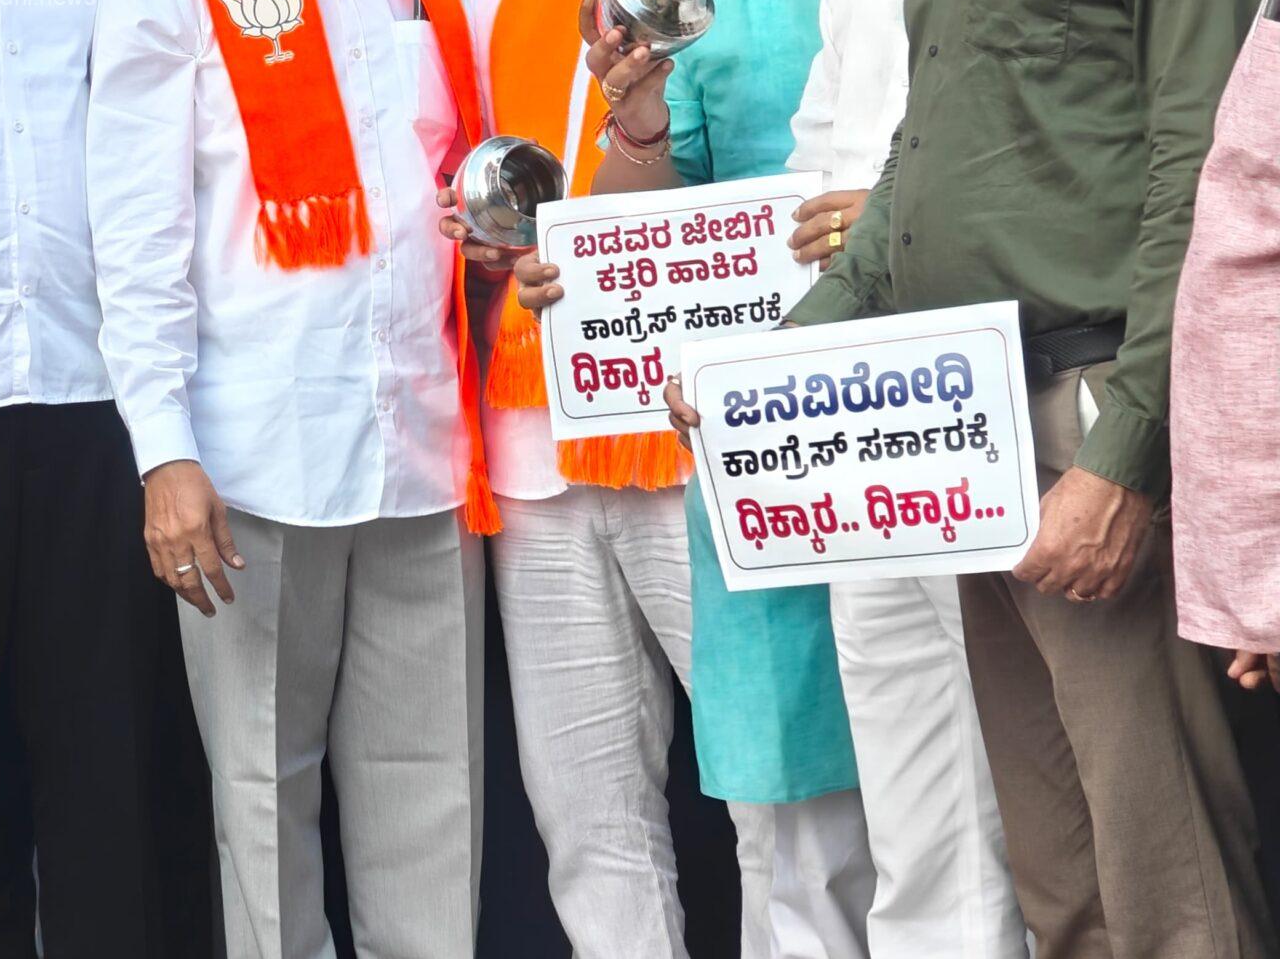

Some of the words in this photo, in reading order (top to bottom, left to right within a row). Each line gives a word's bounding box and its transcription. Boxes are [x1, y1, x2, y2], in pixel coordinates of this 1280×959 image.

[573, 219, 672, 258] ಬಡವರ
[681, 204, 775, 246] ಜೇಬಿಗೆ
[596, 258, 658, 302] ಕತ್ತರಿ
[666, 247, 758, 285] ಹಾಕಿದ
[581, 305, 677, 343] ಕಾಂಗ್ರೆಸ್
[723, 352, 974, 428] ಜನವಿರೋಧಿ
[721, 432, 848, 480] ಕಾಂಗ್ರೆಸ್
[857, 412, 1000, 464] ಸರ್ಕಾರಕ್ಕೆ
[735, 491, 860, 554] ಧಿಕ್ಕಾರ..
[864, 477, 1005, 543] ಧಿಕ್ಕಾರ...
